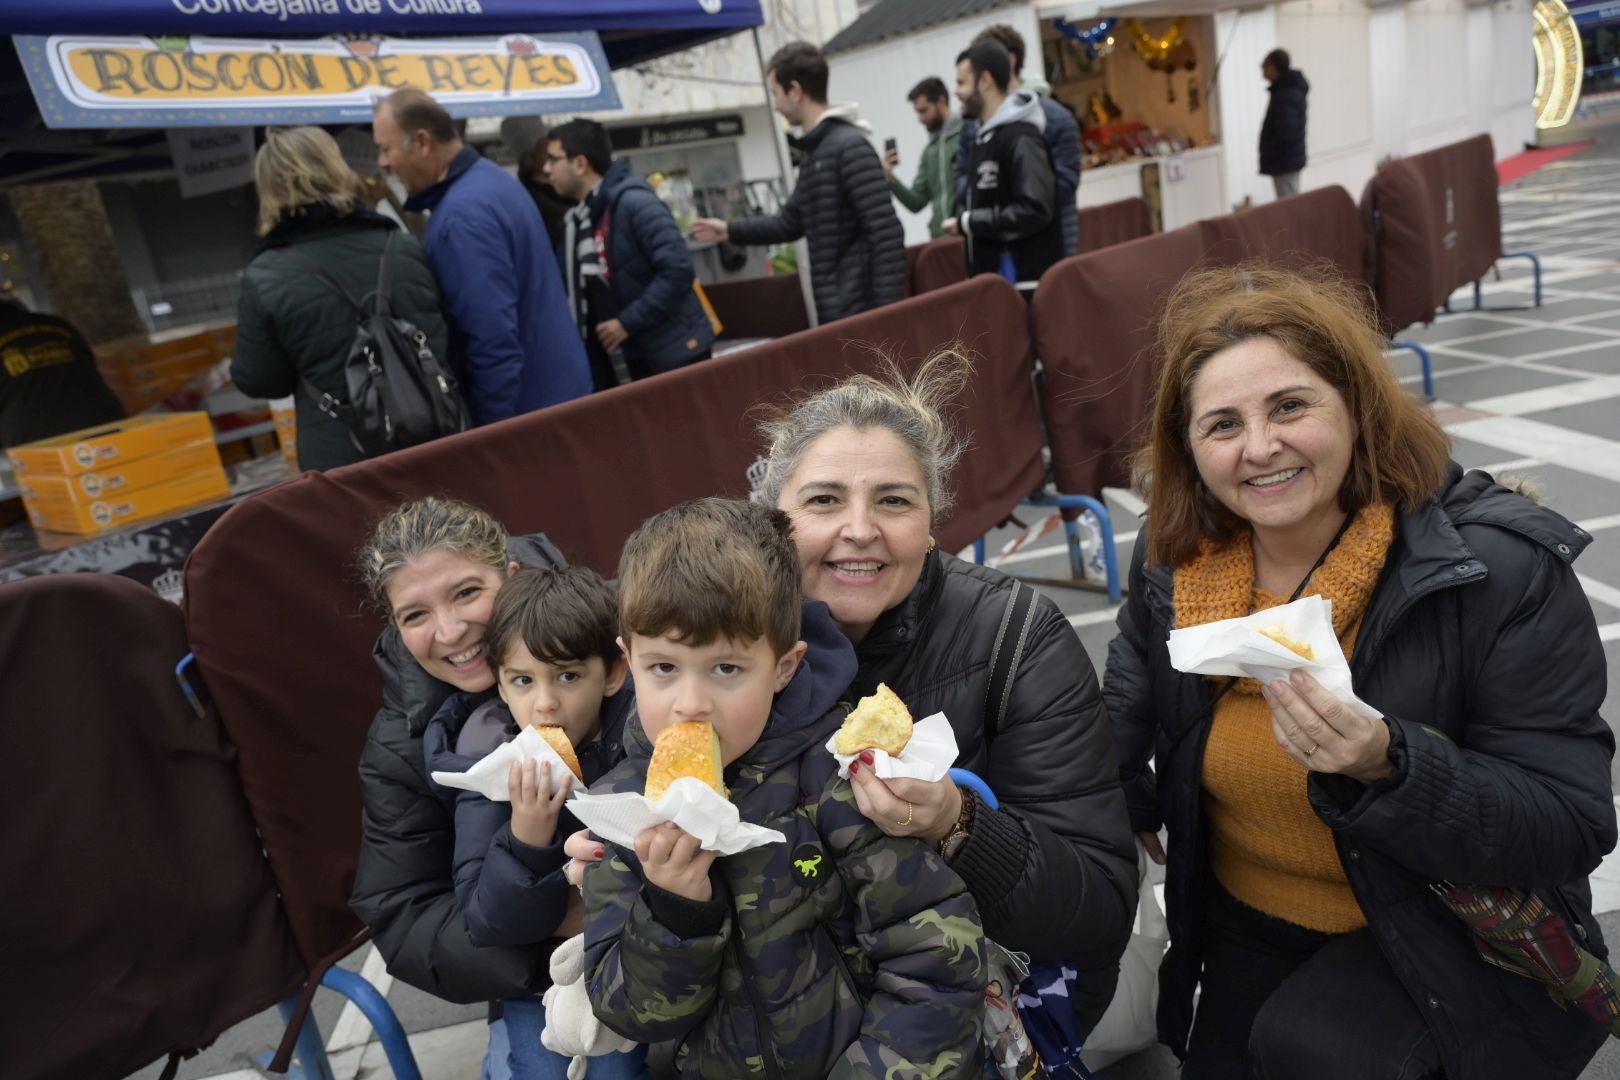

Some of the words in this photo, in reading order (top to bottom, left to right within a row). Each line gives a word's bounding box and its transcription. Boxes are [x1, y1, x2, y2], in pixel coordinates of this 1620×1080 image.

[346, 0, 382, 14] de
[80, 44, 325, 94] ROSCÓN
[337, 54, 409, 93] DE
[418, 54, 579, 96] REYES
